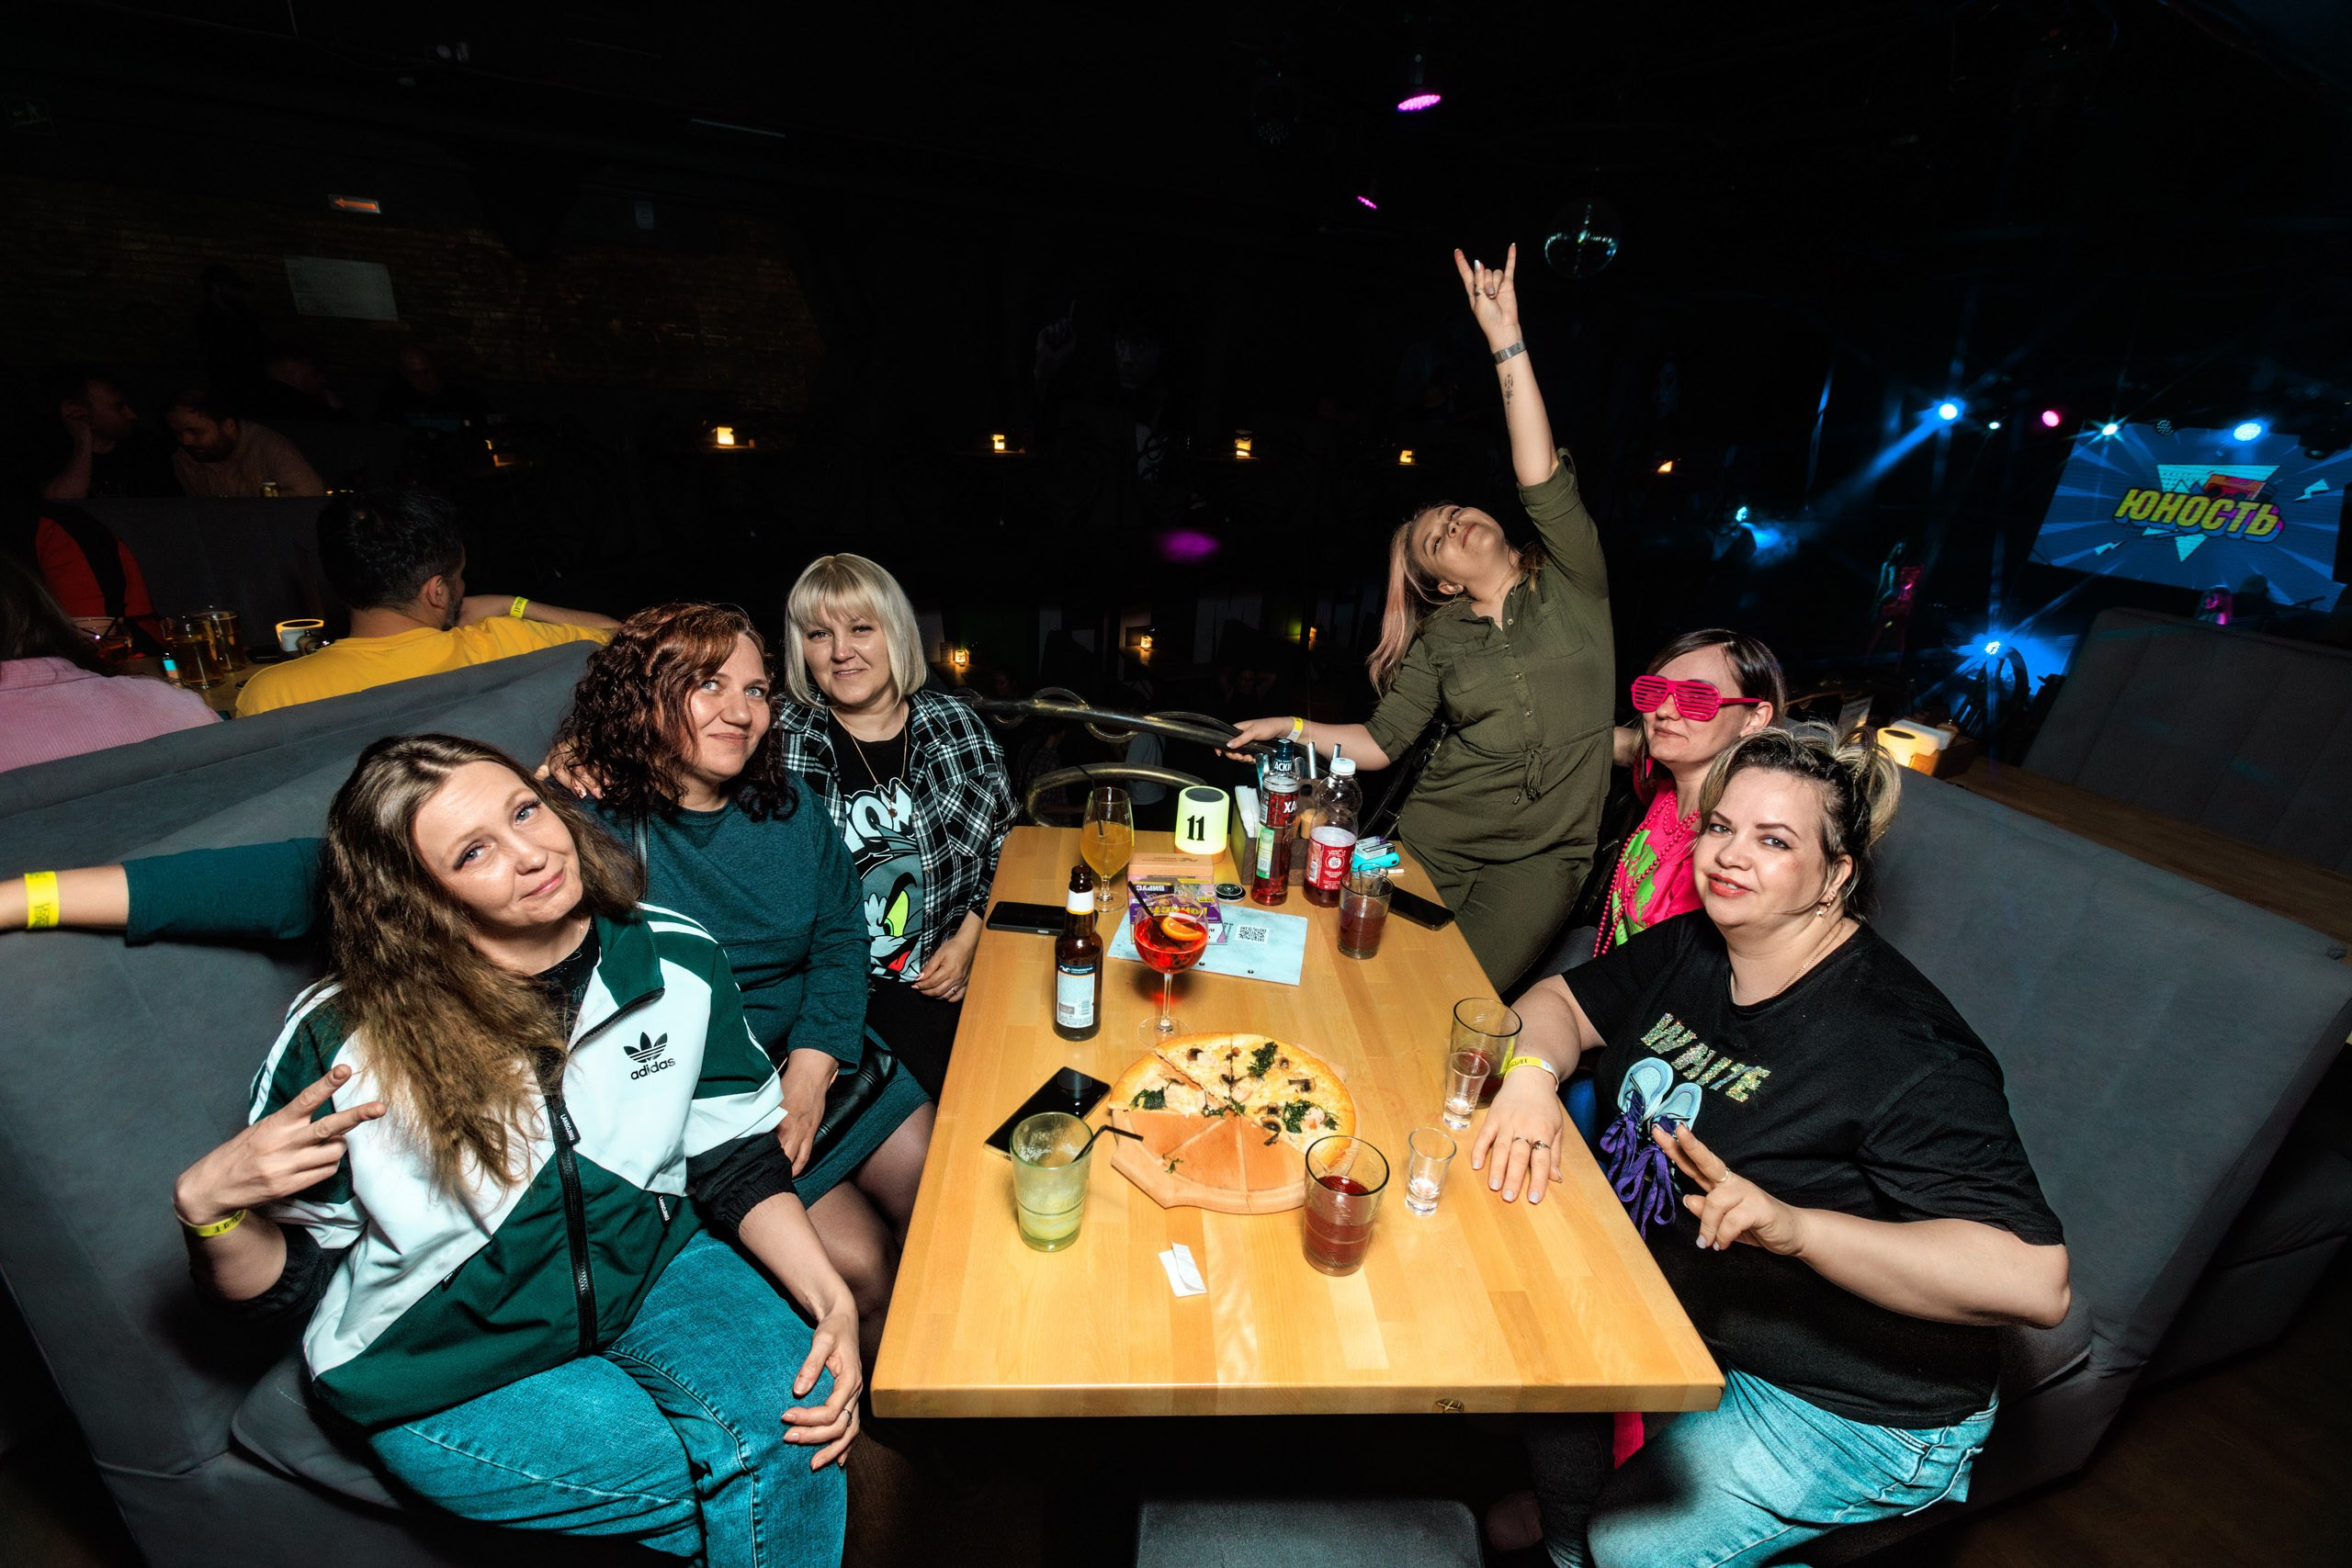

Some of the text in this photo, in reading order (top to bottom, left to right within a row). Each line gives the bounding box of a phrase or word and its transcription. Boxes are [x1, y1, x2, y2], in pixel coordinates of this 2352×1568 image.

[2114, 488, 2279, 536] ЮНОСТЬ
[1186, 815, 1205, 841] 11
[630, 1058, 676, 1080] adidas
